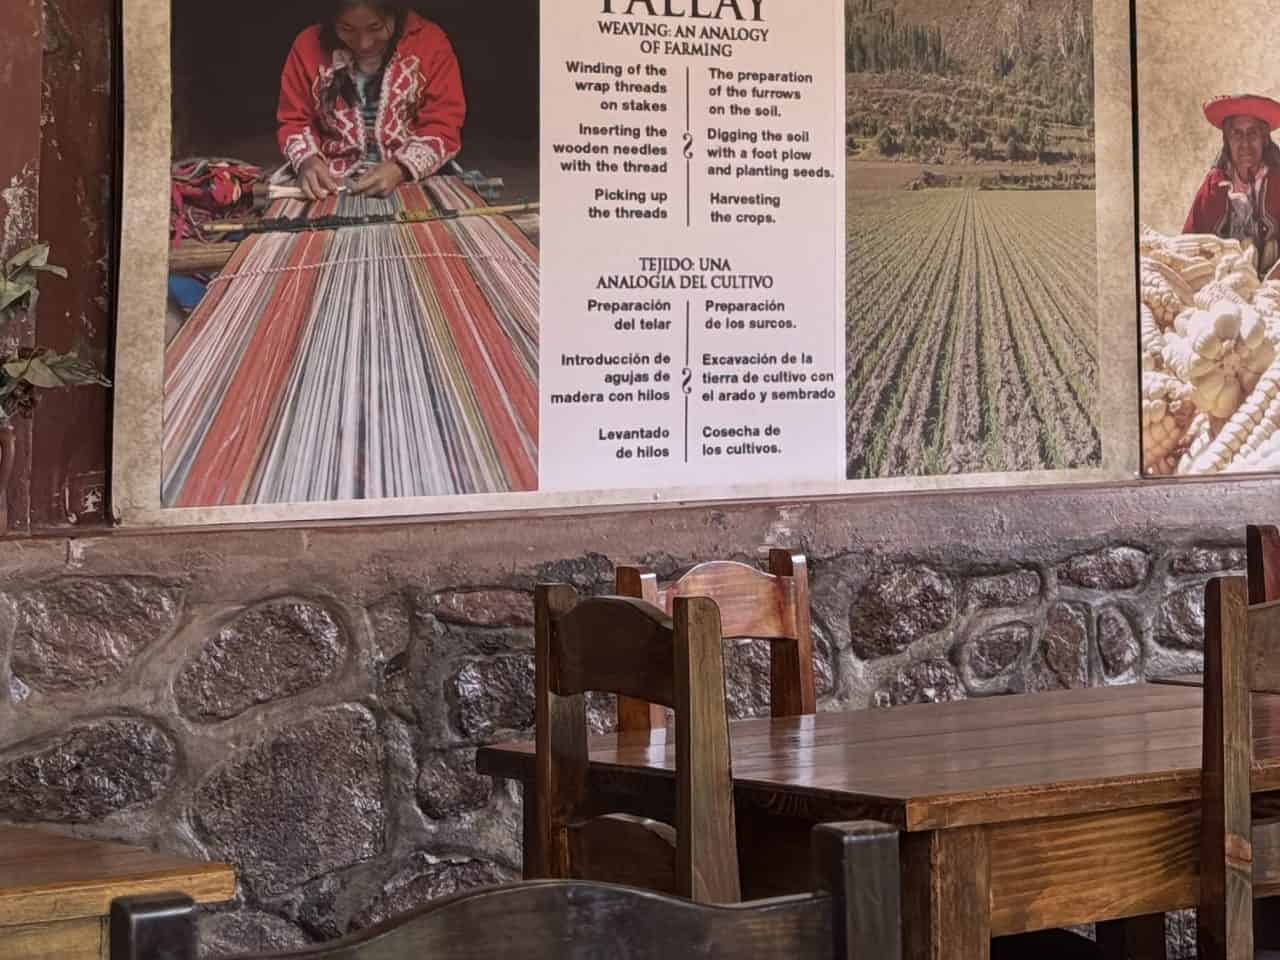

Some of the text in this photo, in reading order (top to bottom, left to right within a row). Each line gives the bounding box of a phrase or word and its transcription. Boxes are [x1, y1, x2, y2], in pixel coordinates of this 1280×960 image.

[673, 24, 696, 38] AN
[698, 25, 768, 42] ANALOGY
[639, 39, 732, 57] OF FARMING
[565, 60, 666, 77] Winding of the
[708, 66, 812, 84] The preparation
[575, 80, 667, 95] wrap threads
[708, 84, 801, 99] of the furrows
[600, 98, 667, 112] on stakes
[708, 103, 781, 117] on the soil.
[579, 122, 667, 139] Inserting the
[707, 127, 809, 144] Digging the soil
[552, 141, 667, 155] wooden needles
[706, 145, 811, 162] with a foot plow
[560, 159, 667, 173] with the thread
[707, 163, 834, 180] and planting seeds.
[594, 187, 667, 204] Picking up
[710, 191, 780, 208] Harvesting
[588, 206, 667, 219] the threads
[710, 210, 776, 226] the crops.
[699, 257, 731, 272] UNA
[679, 274, 707, 289] DEL
[710, 274, 773, 288] CULTIVO
[587, 298, 671, 314] Preparación
[705, 299, 784, 314] Preparación
[613, 317, 672, 330] del telar
[704, 316, 796, 329] de los surcos.
[561, 352, 671, 366] Introducción de
[702, 351, 812, 366] Excavación de la
[604, 369, 670, 386] agujas de
[702, 370, 834, 384] tierra de cultivo con
[550, 388, 670, 404] madera con hilos
[701, 387, 835, 403] el arado y sembrado
[598, 426, 669, 440] Levantado
[702, 423, 780, 438] Cosecha de
[615, 445, 669, 459] de hilos
[702, 441, 781, 456] los cultivos.
